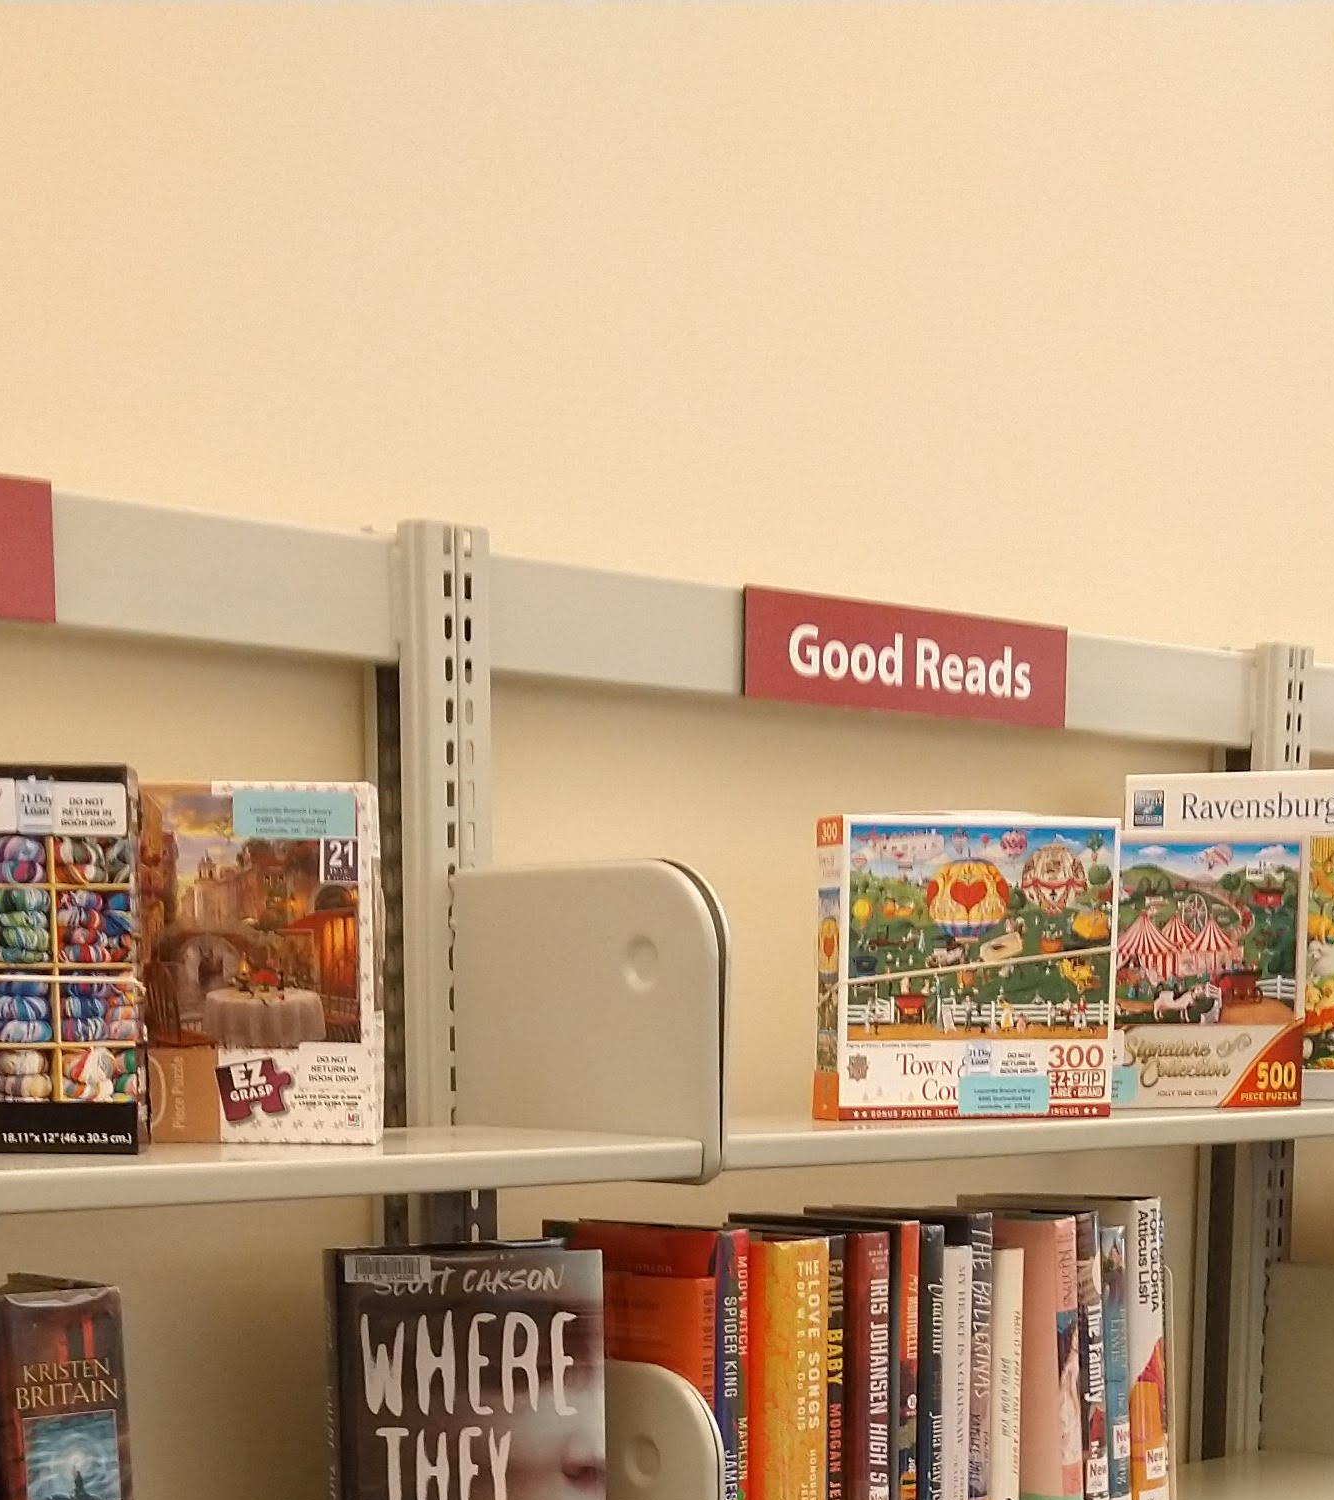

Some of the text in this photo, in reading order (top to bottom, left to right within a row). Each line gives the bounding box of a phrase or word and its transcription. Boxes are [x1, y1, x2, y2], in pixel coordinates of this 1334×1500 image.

[787, 623, 1033, 700] Good Reads
[821, 822, 838, 841] 300
[327, 839, 354, 868] 21
[1048, 1044, 1104, 1069] 300
[1124, 1038, 1210, 1067] Signature
[230, 1064, 266, 1085] EZ
[1140, 1059, 1232, 1088] Collection
[1257, 1062, 1297, 1090] 500
[229, 1084, 274, 1101] GRASP
[1240, 1092, 1298, 1101] PIECE PUZZLE
[462, 1264, 565, 1294] CARSON
[723, 1296, 738, 1399] SPIDER KING
[808, 1279, 820, 1429] LOVE SONGS
[22, 1357, 110, 1383] KRISTEN
[360, 1309, 578, 1418] WHERE
[870, 1278, 888, 1466] IRIS JOHANSEN HIGH
[15, 1379, 120, 1410] BRITAIN
